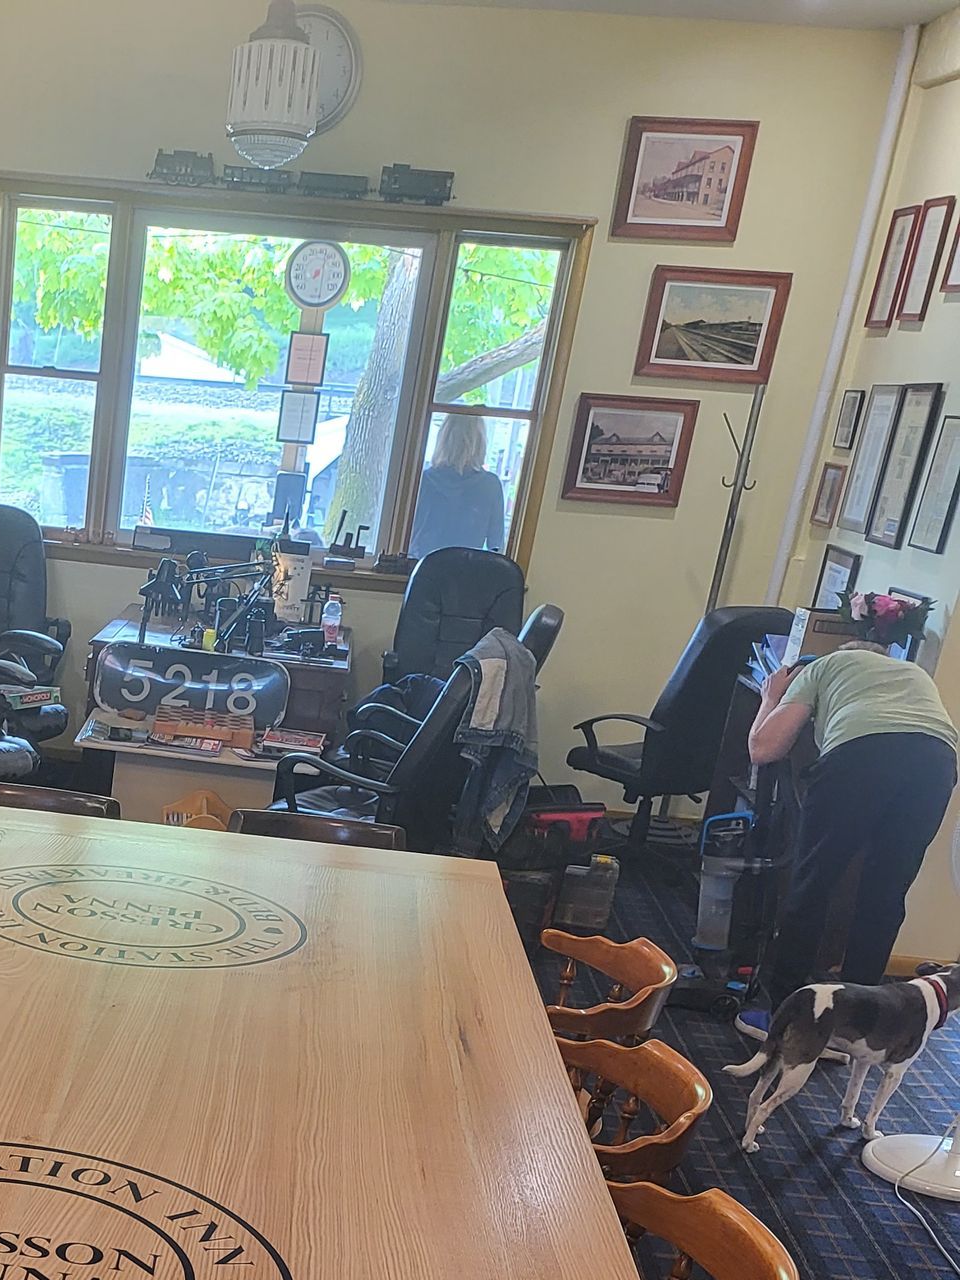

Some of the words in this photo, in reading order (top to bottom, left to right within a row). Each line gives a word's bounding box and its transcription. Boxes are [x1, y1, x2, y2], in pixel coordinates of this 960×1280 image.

[120, 658, 258, 716] 5218
[202, 884, 230, 896] &
[32, 901, 224, 935] CRESSON
[62, 893, 203, 921] PENNA
[23, 931, 213, 963] STATION
[215, 939, 282, 960] THE
[165, 1207, 257, 1270] INN
